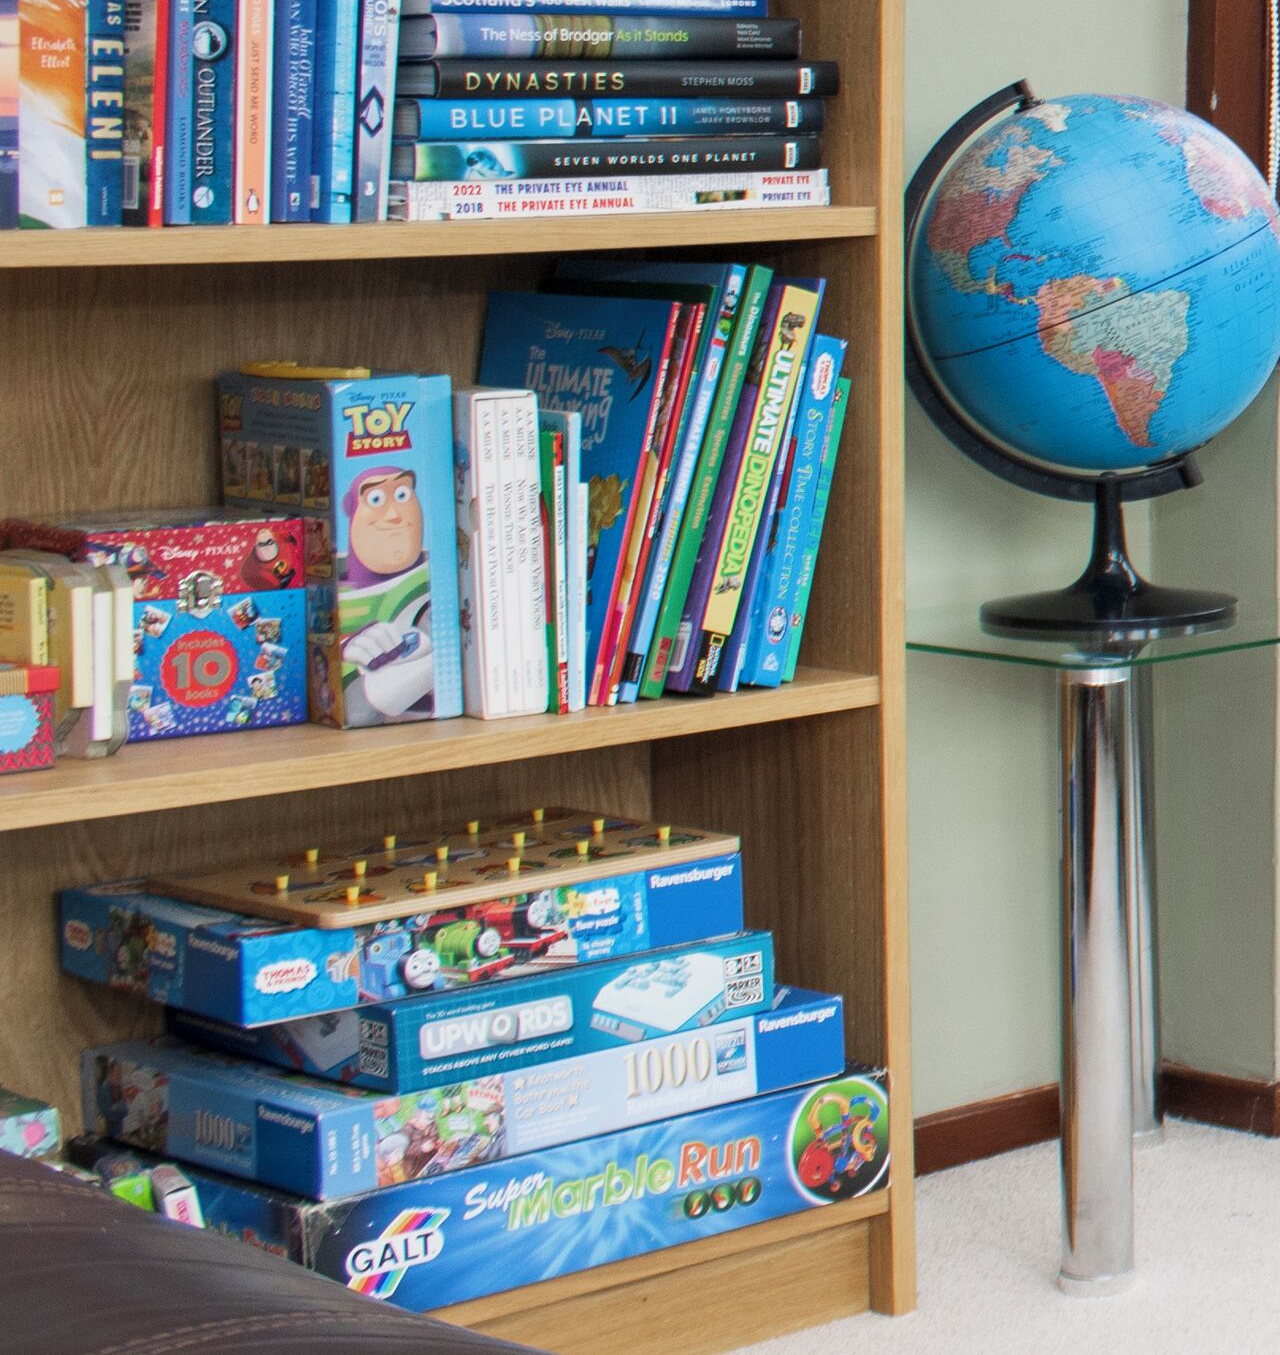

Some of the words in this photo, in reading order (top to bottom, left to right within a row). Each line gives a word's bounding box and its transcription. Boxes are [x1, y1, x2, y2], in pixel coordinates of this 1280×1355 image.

[289, 23, 301, 56] WHO
[300, 27, 313, 57] John
[480, 27, 507, 41] The
[510, 28, 541, 42] Ness
[544, 27, 558, 42] of
[560, 29, 614, 46] Brodgar
[615, 30, 632, 42] As
[633, 30, 642, 42] it
[645, 30, 689, 43] Stands
[250, 41, 259, 65] JUST
[250, 67, 259, 94] SEND
[288, 57, 300, 111] FORGOT
[298, 59, 312, 119] O'Farrell
[465, 71, 625, 91] DYNASTIES
[681, 77, 726, 86] STEPHEN
[728, 77, 754, 86] MOSS
[90, 38, 124, 160] ELENI
[249, 96, 258, 109] ME
[693, 107, 717, 115] JAMES
[195, 68, 216, 179] OUTLANDER
[249, 111, 258, 145] WORD
[287, 116, 299, 142] HIS
[451, 107, 525, 129] BLUE
[539, 106, 648, 127] PLANET
[660, 106, 677, 126] II
[725, 116, 771, 124] BROWNLOW
[286, 146, 298, 184] WIFE
[553, 156, 600, 166] SEVEN
[607, 155, 664, 165] WORLDS
[672, 153, 699, 163] ONE
[705, 152, 757, 163] PLANET
[453, 184, 482, 196] 2022
[495, 184, 513, 195] THE
[518, 182, 562, 194] PRIVATE
[565, 182, 583, 193] EYE
[587, 180, 628, 192] ANNUAL
[762, 176, 795, 185] PRIVATE
[796, 175, 810, 184] EYE
[456, 202, 484, 214] 2018
[498, 201, 517, 212] THE
[521, 200, 567, 211] PRIVATE
[569, 198, 588, 210] EYE
[592, 197, 635, 209] ANNUAL
[762, 192, 795, 202] PRIVATE
[797, 191, 811, 201] EYE
[545, 320, 574, 343] Disney
[577, 328, 606, 341] PIXAR
[738, 304, 760, 356] Dinosaurs
[529, 345, 546, 360] The
[525, 361, 614, 398] ULTIMATE
[721, 362, 743, 422] Discoveries
[349, 392, 375, 402] Disney
[380, 392, 407, 400] PIXAR
[753, 349, 795, 454] ULTIMATE
[343, 401, 416, 436] TOY
[802, 408, 823, 457] STORY
[352, 435, 406, 450] STORY
[484, 432, 493, 462] MILNE
[502, 429, 511, 460] MILNE
[527, 429, 536, 460] MILNE
[709, 428, 725, 468] Species
[795, 464, 813, 507] TIME
[691, 474, 712, 529] Extinction
[721, 455, 769, 577] DINOPEDIA
[661, 508, 680, 562] ANNUAL
[158, 545, 199, 560] Disney
[205, 546, 241, 556] PIXAR
[778, 508, 801, 600] COLLECTION
[652, 565, 664, 601] 2020
[171, 650, 231, 689] 10
[650, 864, 734, 889] Ravensburger
[575, 918, 594, 931] floor
[261, 964, 310, 981] THOMAS
[727, 978, 761, 992] PARKER
[424, 1000, 569, 1053] UPWORDS
[758, 1004, 838, 1034] Ravensburger
[422, 1061, 450, 1076] STACKS
[451, 1057, 478, 1070] ABOVE
[480, 1054, 498, 1064] ANY
[499, 1048, 526, 1059] OTHER
[526, 1044, 550, 1054] WORD
[624, 1038, 712, 1099] 1000
[257, 1103, 317, 1135] Ravensburger
[463, 1172, 547, 1222] Super
[507, 1153, 674, 1231] Marble
[677, 1135, 762, 1190] Run
[350, 1230, 436, 1276] GALT
